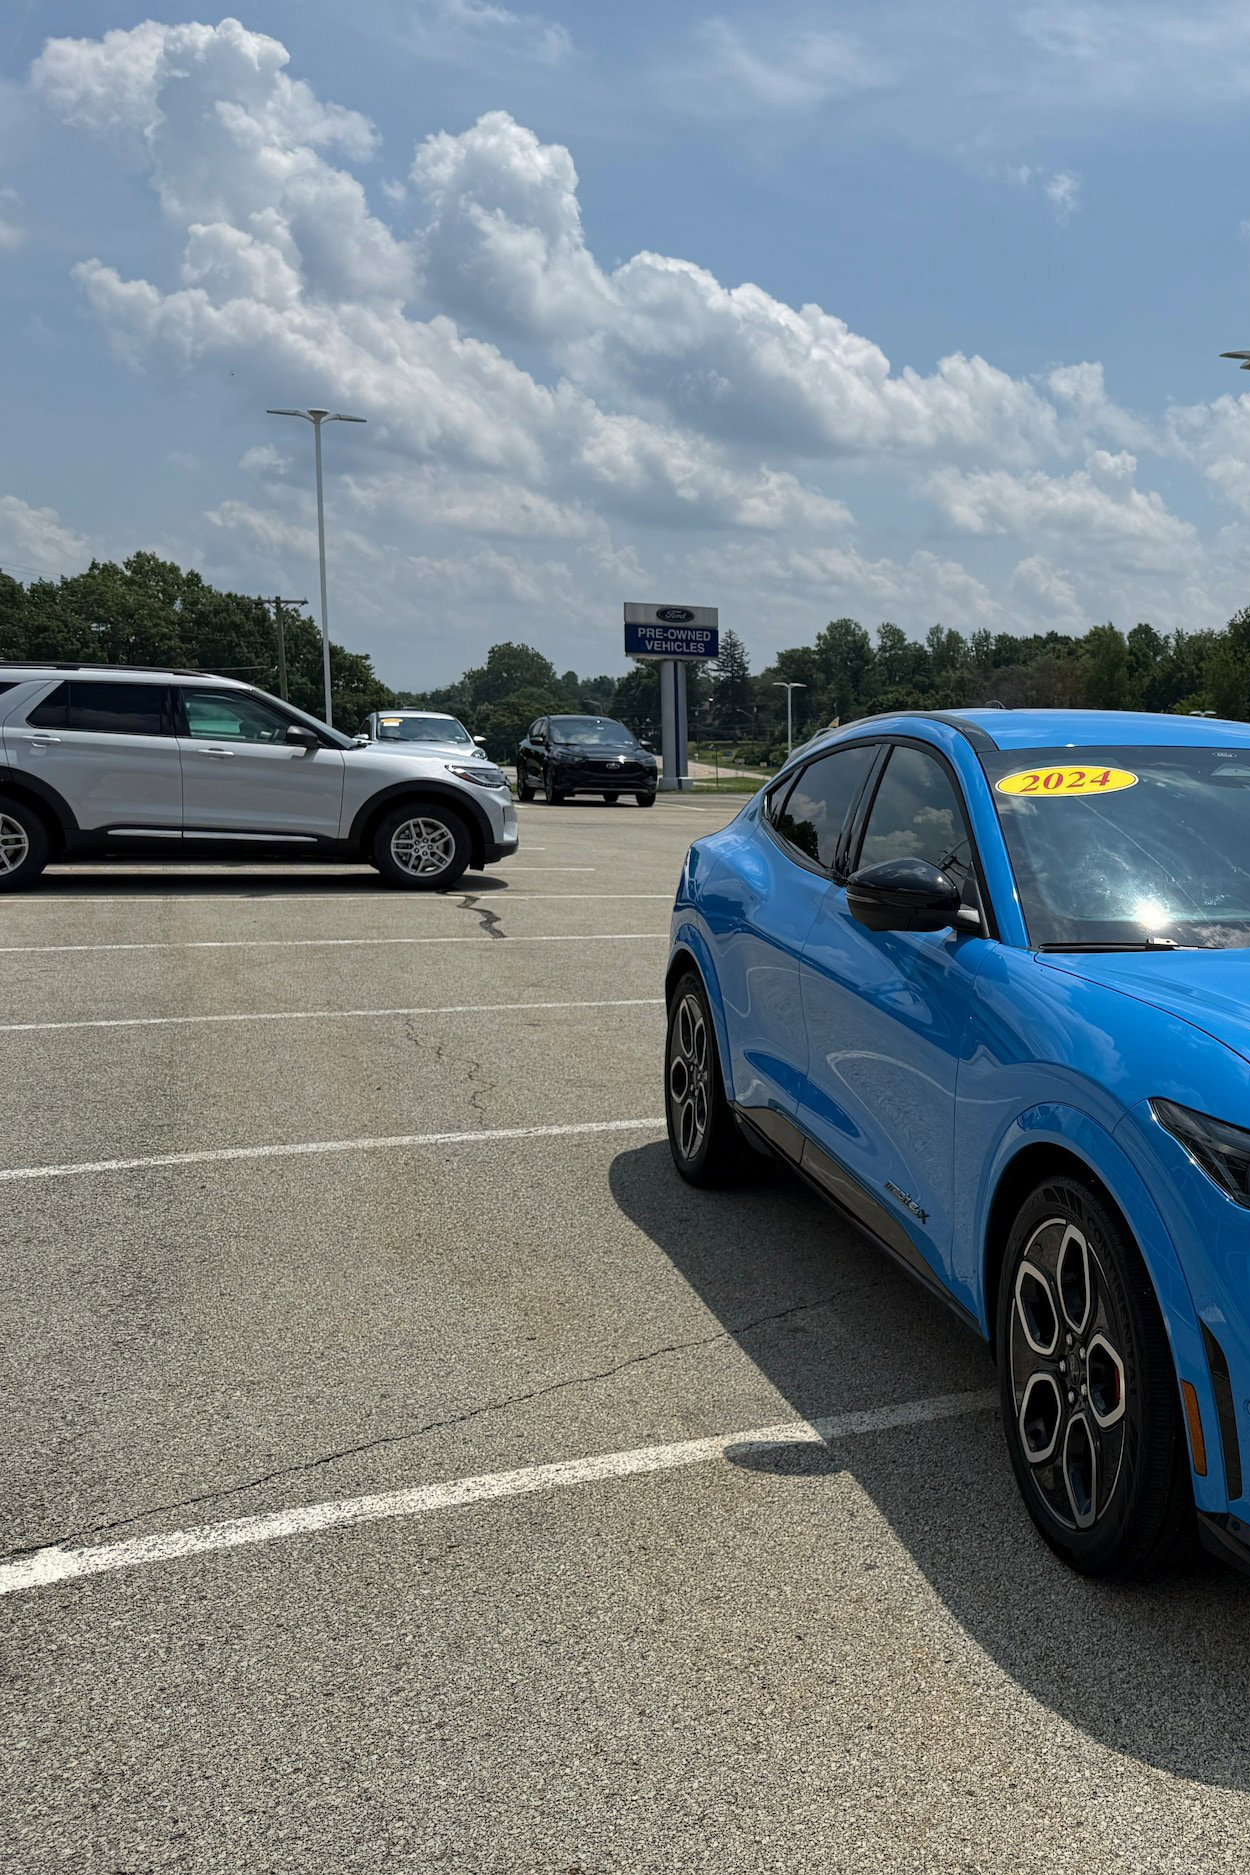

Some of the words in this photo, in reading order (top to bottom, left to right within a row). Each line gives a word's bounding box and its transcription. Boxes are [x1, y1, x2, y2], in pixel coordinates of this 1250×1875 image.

[638, 627, 711, 641] PRE-OWNED
[646, 640, 705, 653] VEHICLES
[1019, 770, 1111, 793] 2024
